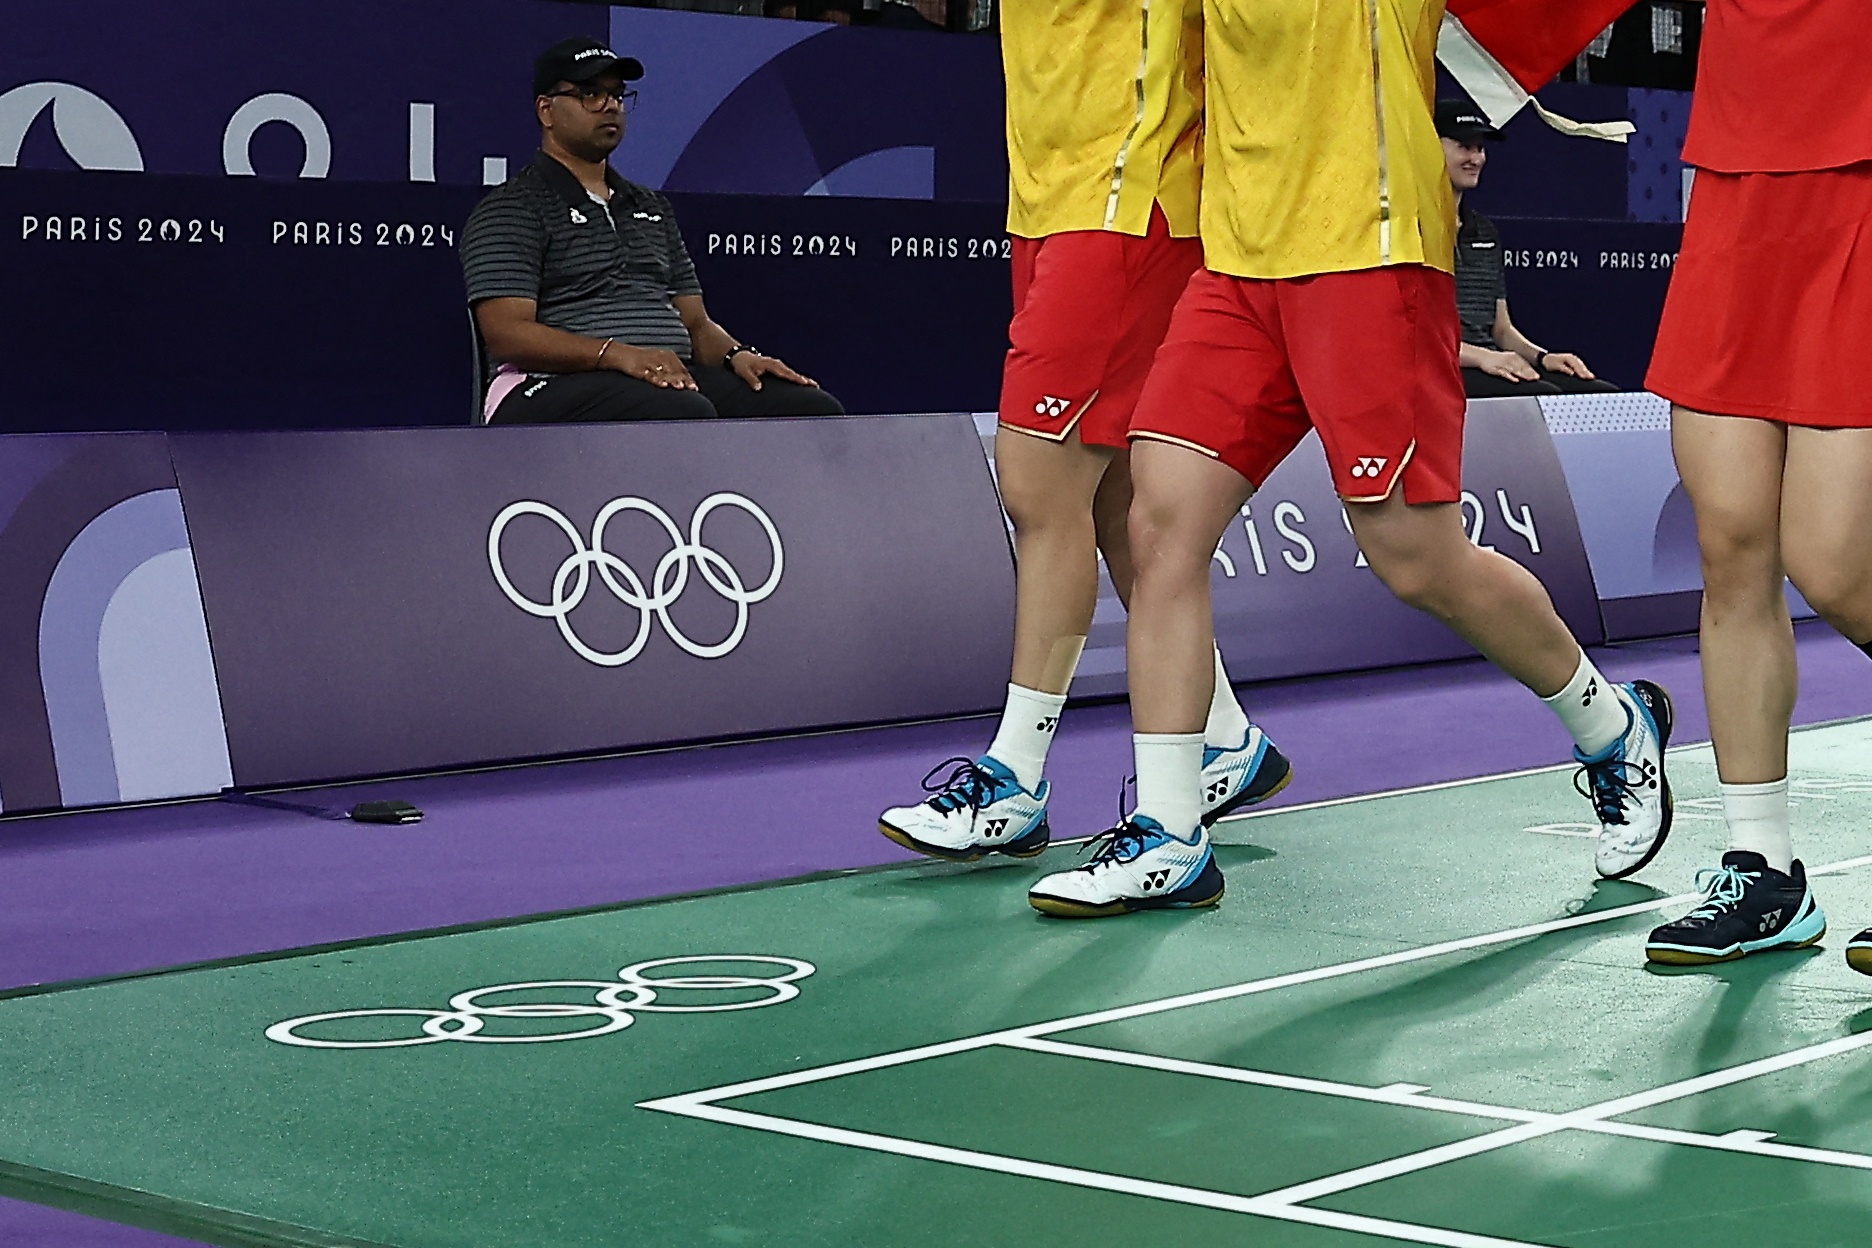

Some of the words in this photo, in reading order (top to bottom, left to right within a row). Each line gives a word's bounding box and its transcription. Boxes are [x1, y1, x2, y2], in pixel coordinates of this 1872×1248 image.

[137, 218, 225, 243] 2024
[375, 223, 454, 247] 2024
[792, 234, 856, 257] 2024
[967, 238, 1012, 259] 202
[1503, 249, 1531, 268] RIS
[1535, 250, 1579, 268] 2024
[1599, 252, 1646, 270] PARIS
